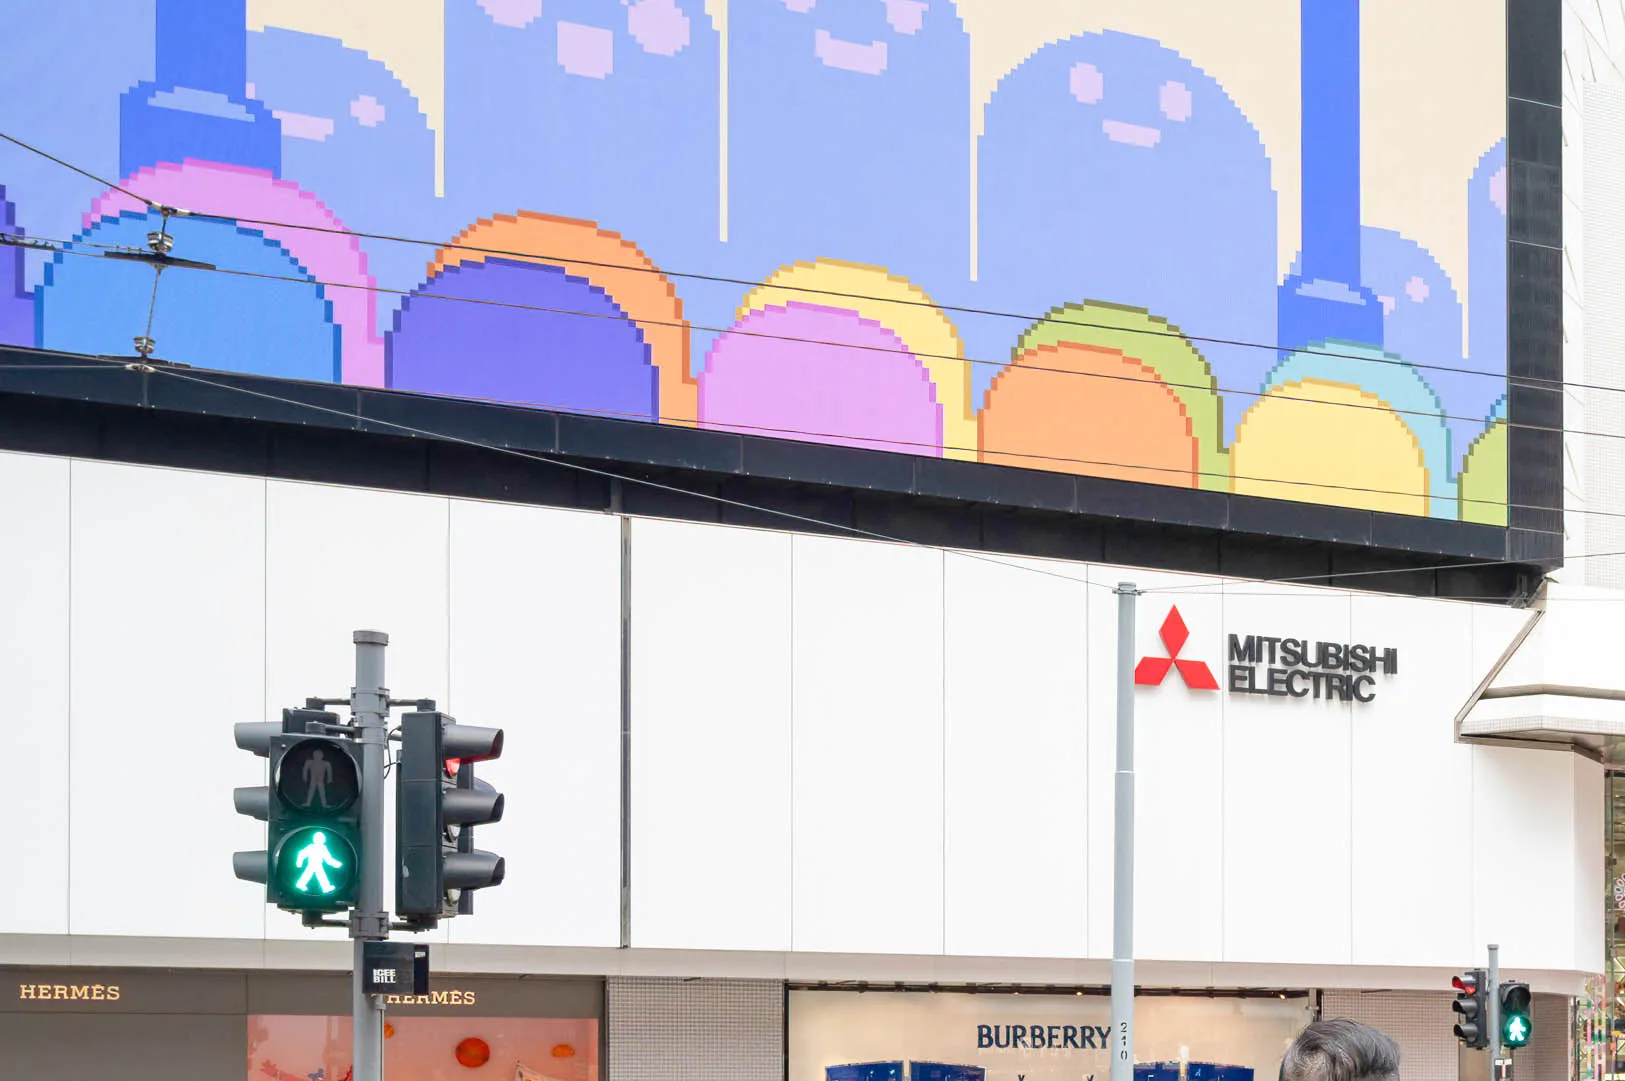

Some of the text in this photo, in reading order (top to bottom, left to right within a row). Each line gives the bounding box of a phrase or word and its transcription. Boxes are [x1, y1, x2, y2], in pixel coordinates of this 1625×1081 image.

[1228, 632, 1398, 676] MITSUBISHI
[1228, 665, 1377, 704] ELECTRIC
[977, 1024, 1112, 1050] BURBERRY
